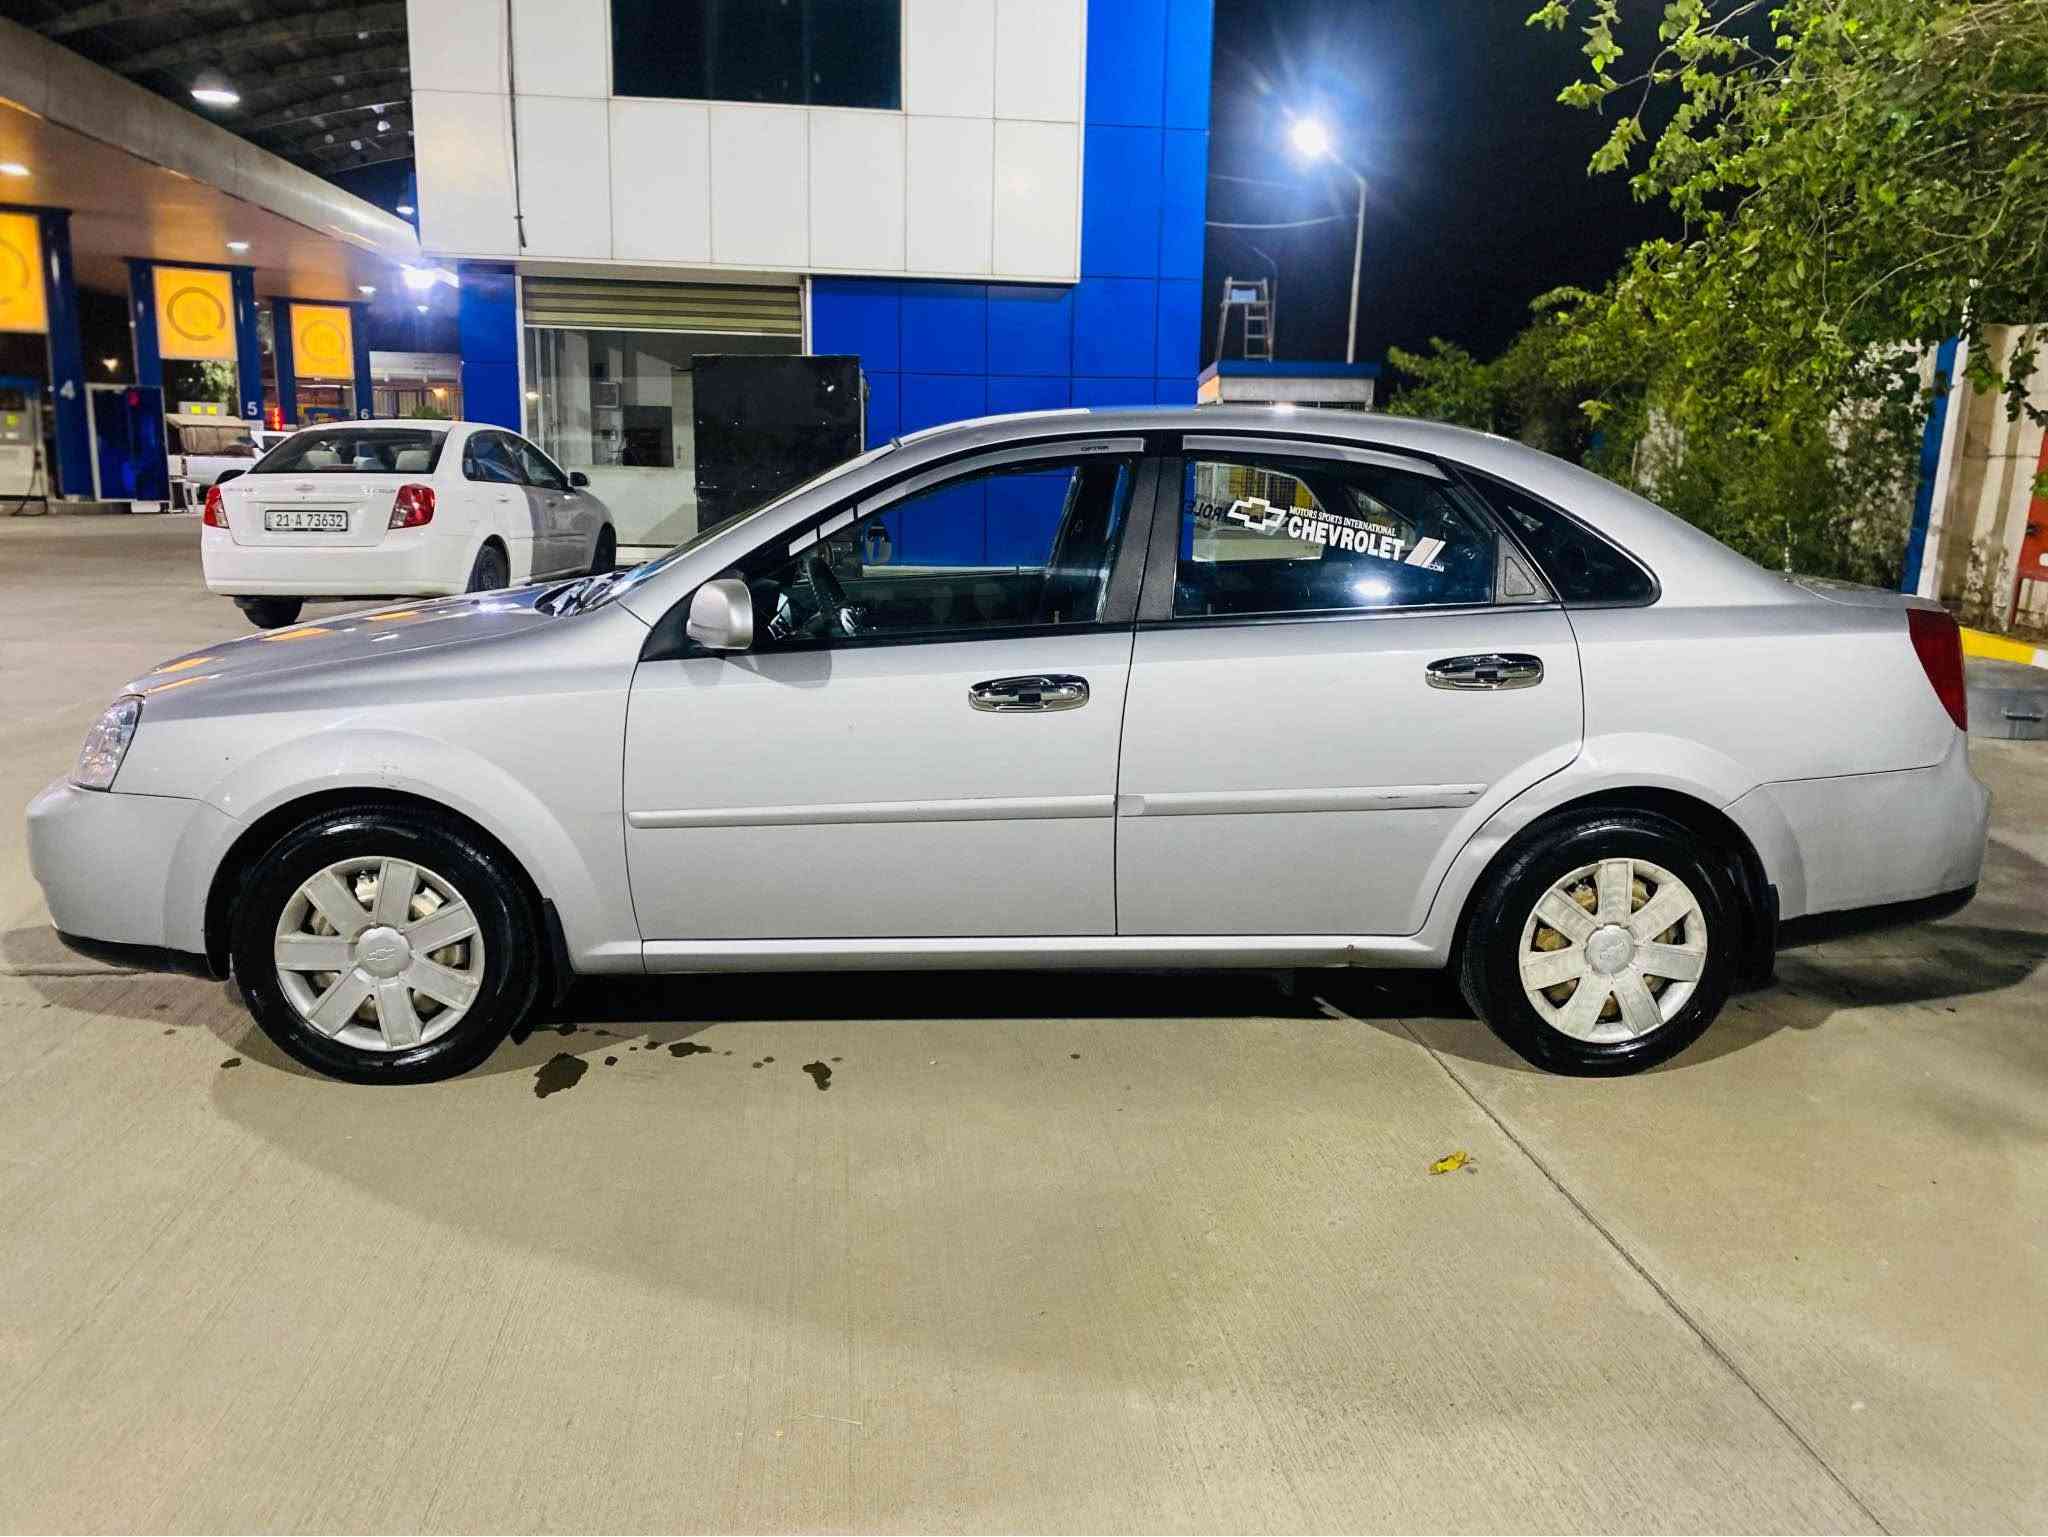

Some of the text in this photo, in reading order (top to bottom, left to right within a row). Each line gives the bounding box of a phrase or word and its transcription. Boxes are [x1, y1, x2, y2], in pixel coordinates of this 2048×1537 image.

[247, 401, 257, 416] 5
[360, 408, 369, 419] 6
[276, 514, 290, 527] 21
[294, 514, 302, 527] A
[307, 514, 343, 527] 73632
[1289, 505, 1397, 537] MOTORS SPORTS INTERNATIONAL
[1287, 516, 1405, 561] CHEVROLET
